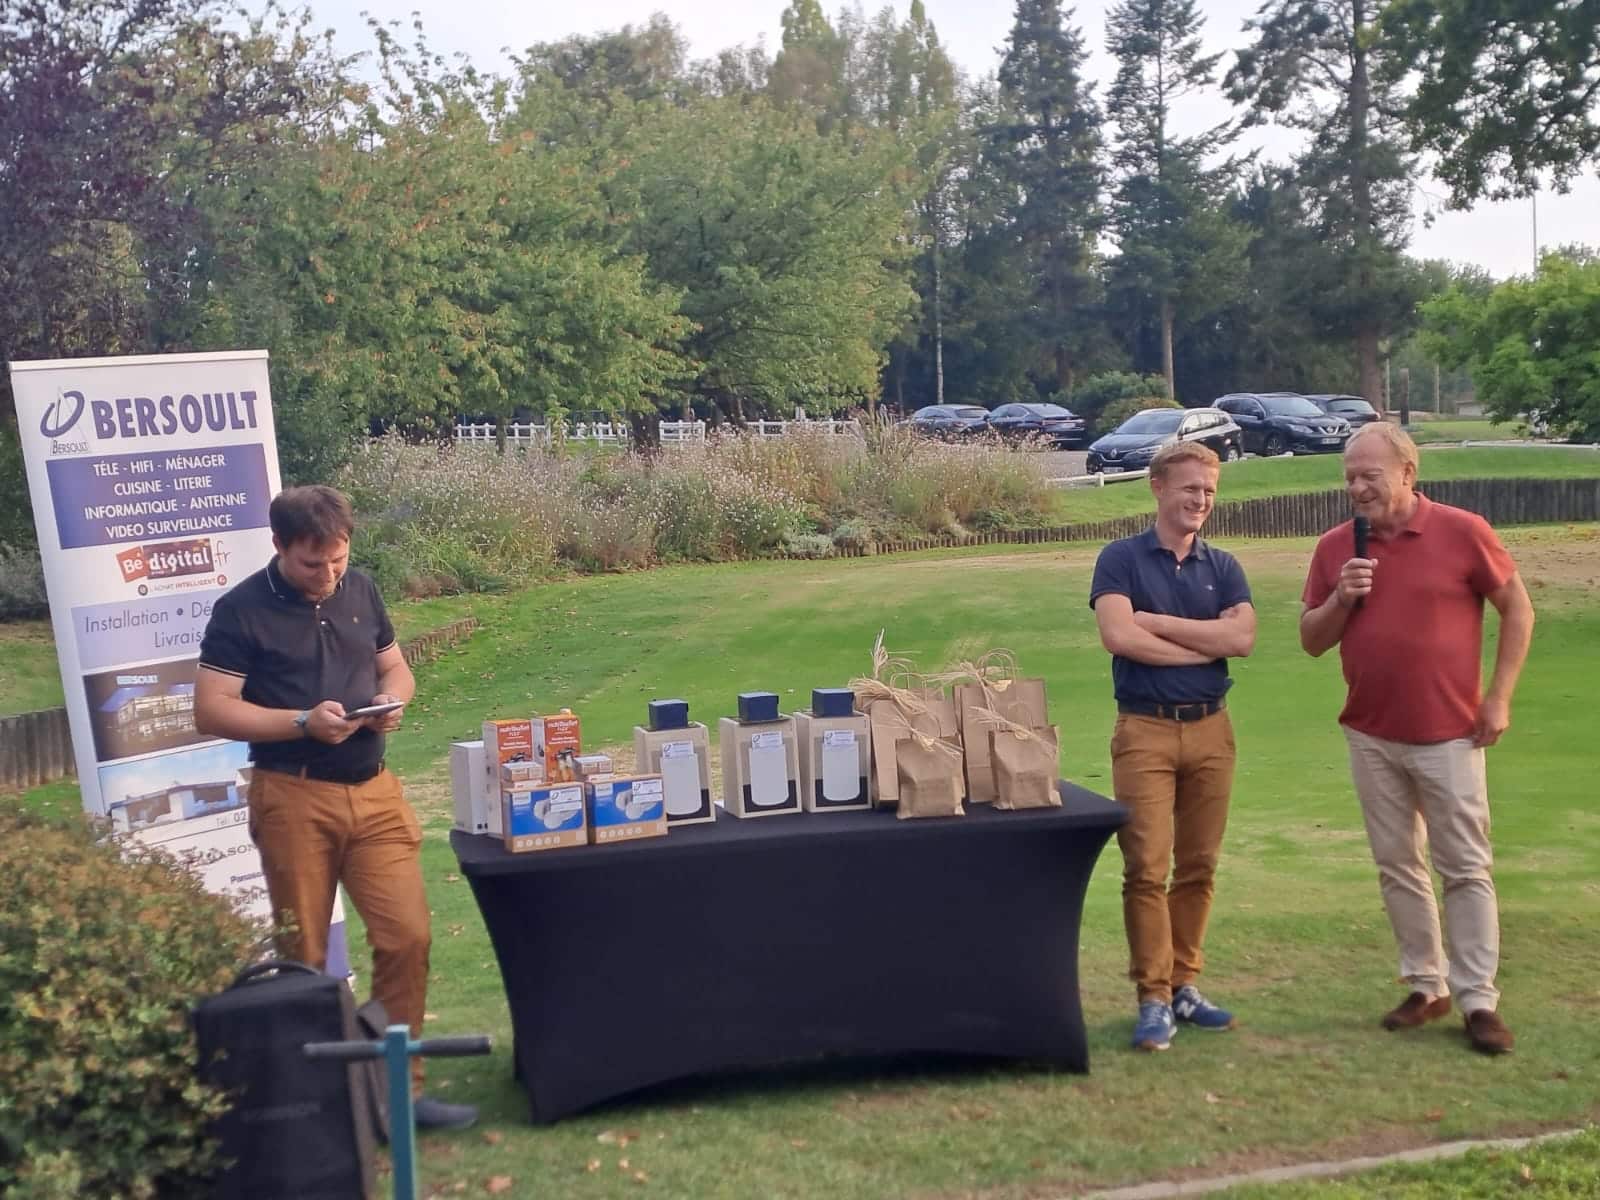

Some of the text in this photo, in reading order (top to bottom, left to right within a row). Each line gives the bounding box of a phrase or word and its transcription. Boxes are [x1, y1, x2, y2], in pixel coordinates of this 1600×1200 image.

[91, 391, 257, 439] BERSOULT
[165, 454, 226, 471] MÉNAGER
[114, 479, 163, 496] CUISINE
[173, 475, 213, 491] LITERIE
[84, 499, 178, 520] INFORMATIQUE
[190, 492, 248, 510] ANTENNE
[104, 514, 233, 539] VIDEO SURVEILLANCE
[85, 601, 212, 633] Installation Dé
